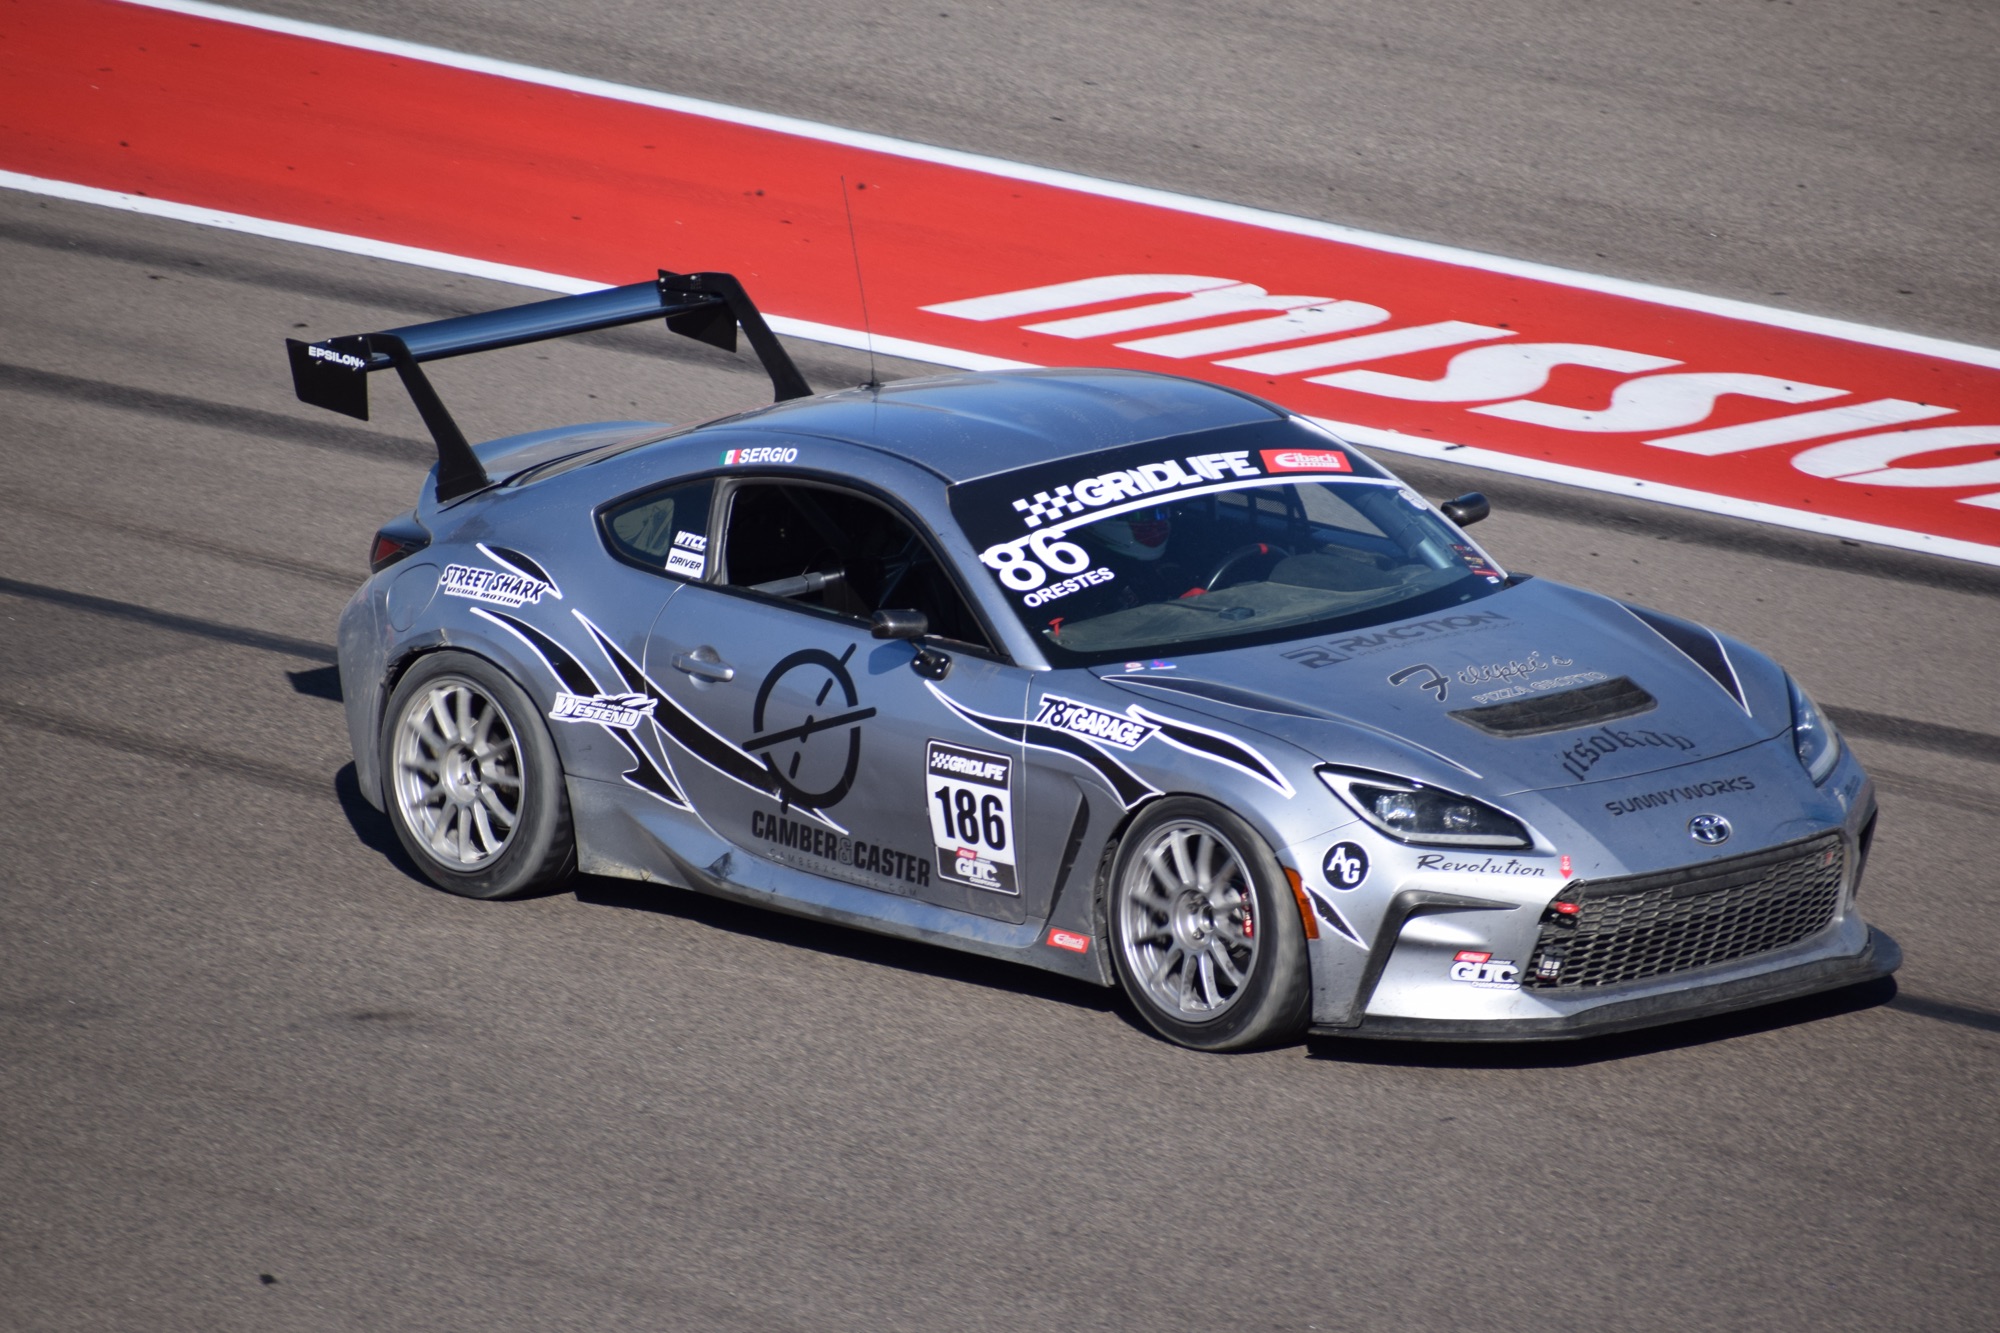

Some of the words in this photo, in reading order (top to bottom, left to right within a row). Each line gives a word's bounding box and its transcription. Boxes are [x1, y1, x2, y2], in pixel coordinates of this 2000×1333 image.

[738, 447, 798, 463] SERGIO
[1073, 450, 1261, 506] GRIDLIFE
[669, 555, 702, 571] DRIVER
[981, 528, 1090, 591] 86
[442, 566, 492, 588] STREET
[492, 574, 547, 601] SHARK
[446, 586, 479, 597] VISUAL
[480, 592, 521, 605] MOTION
[1024, 567, 1115, 607] ORESTES
[1387, 651, 1573, 702] Filippi's
[1472, 685, 1535, 704] PIZZA
[1530, 671, 1607, 690] GROTTO
[554, 696, 639, 726] WESTEND
[948, 755, 1007, 781] GRIDLIFE
[1605, 776, 1755, 816] SUNNYWORKS
[935, 785, 1006, 851] 186
[955, 857, 998, 881] GLTC
[1416, 854, 1545, 877] Revolution
[1450, 961, 1519, 983] GLTC
